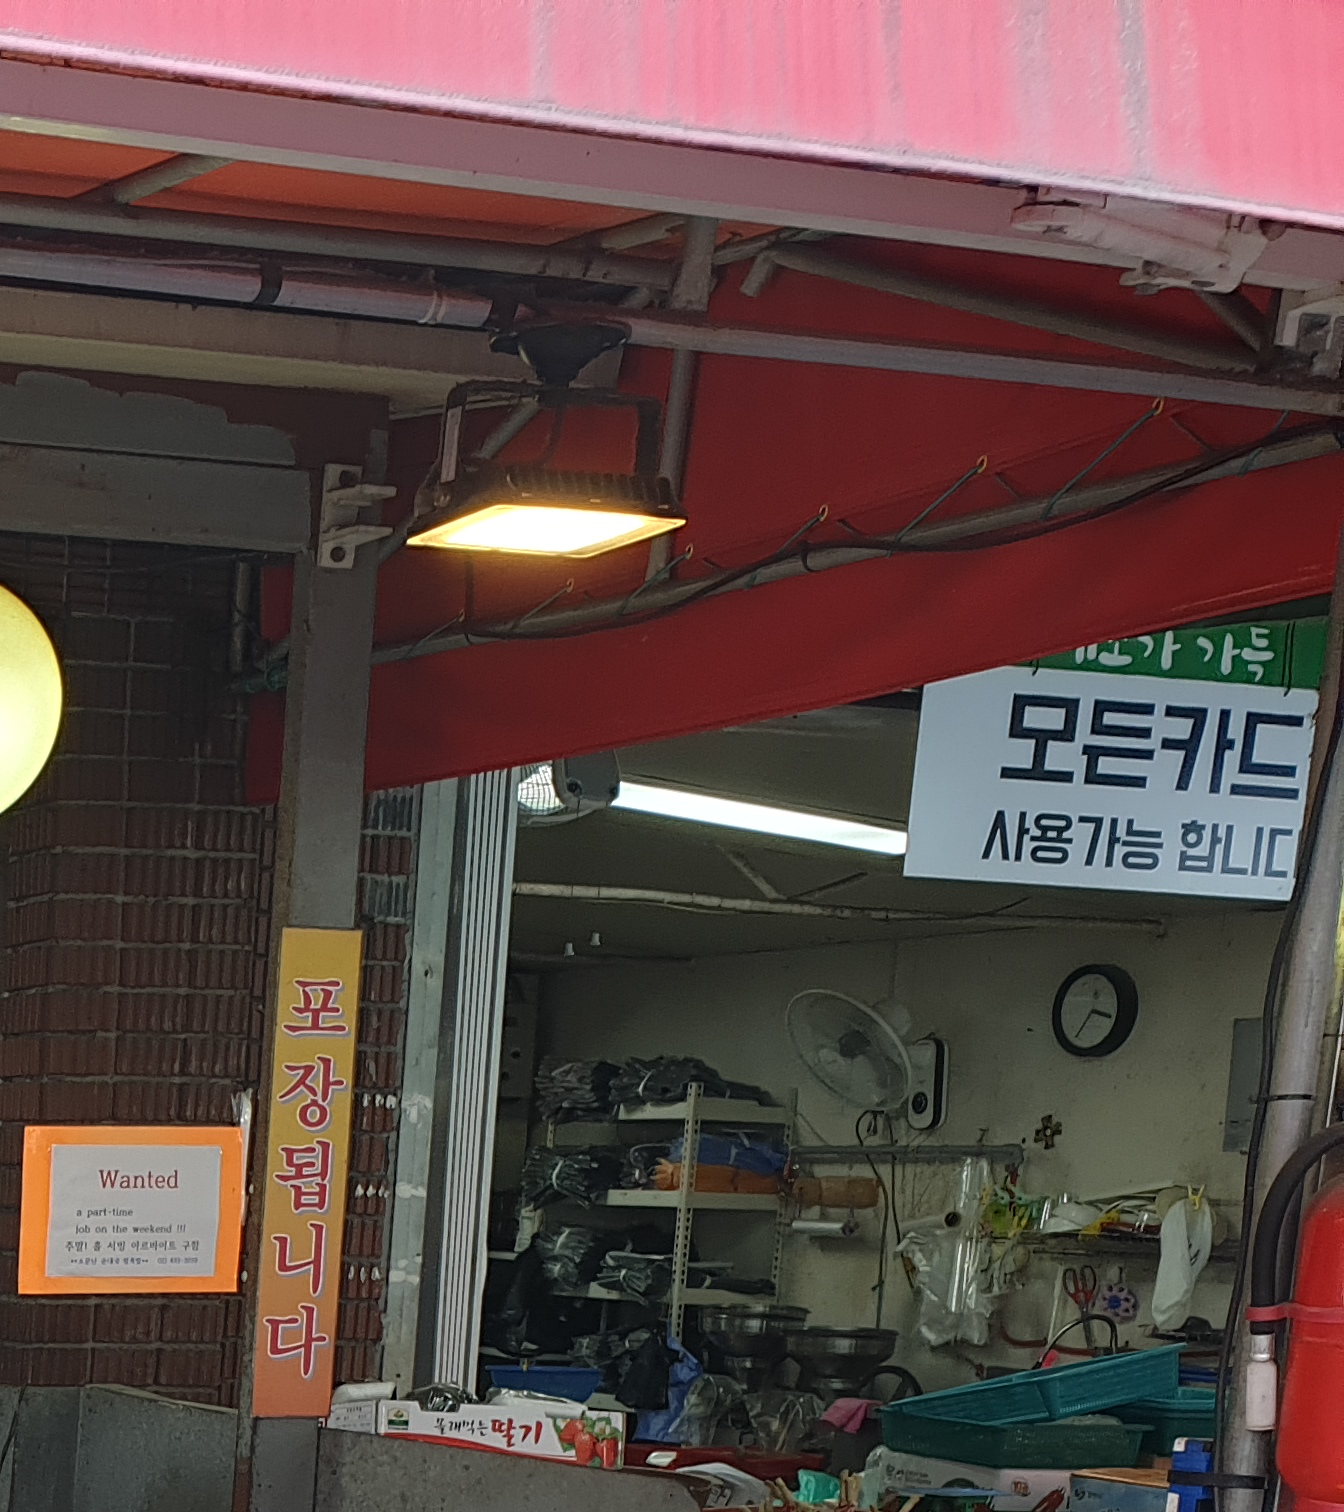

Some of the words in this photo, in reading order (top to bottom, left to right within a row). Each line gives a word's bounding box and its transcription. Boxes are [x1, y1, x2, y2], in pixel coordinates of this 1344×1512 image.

[1197, 626, 1275, 682] 가득
[999, 693, 1305, 801] 모든카드
[98, 1168, 179, 1190] Wanted
[264, 976, 349, 1379] 포장됩니다
[76, 1209, 82, 1217] a
[87, 1207, 133, 1219] part-time
[75, 1224, 91, 1235] job
[95, 1226, 107, 1234] on
[112, 1224, 128, 1234] the
[133, 1224, 172, 1234] weekend
[131, 1240, 177, 1251] 아르바이트
[491, 1417, 543, 1447] 딸기
